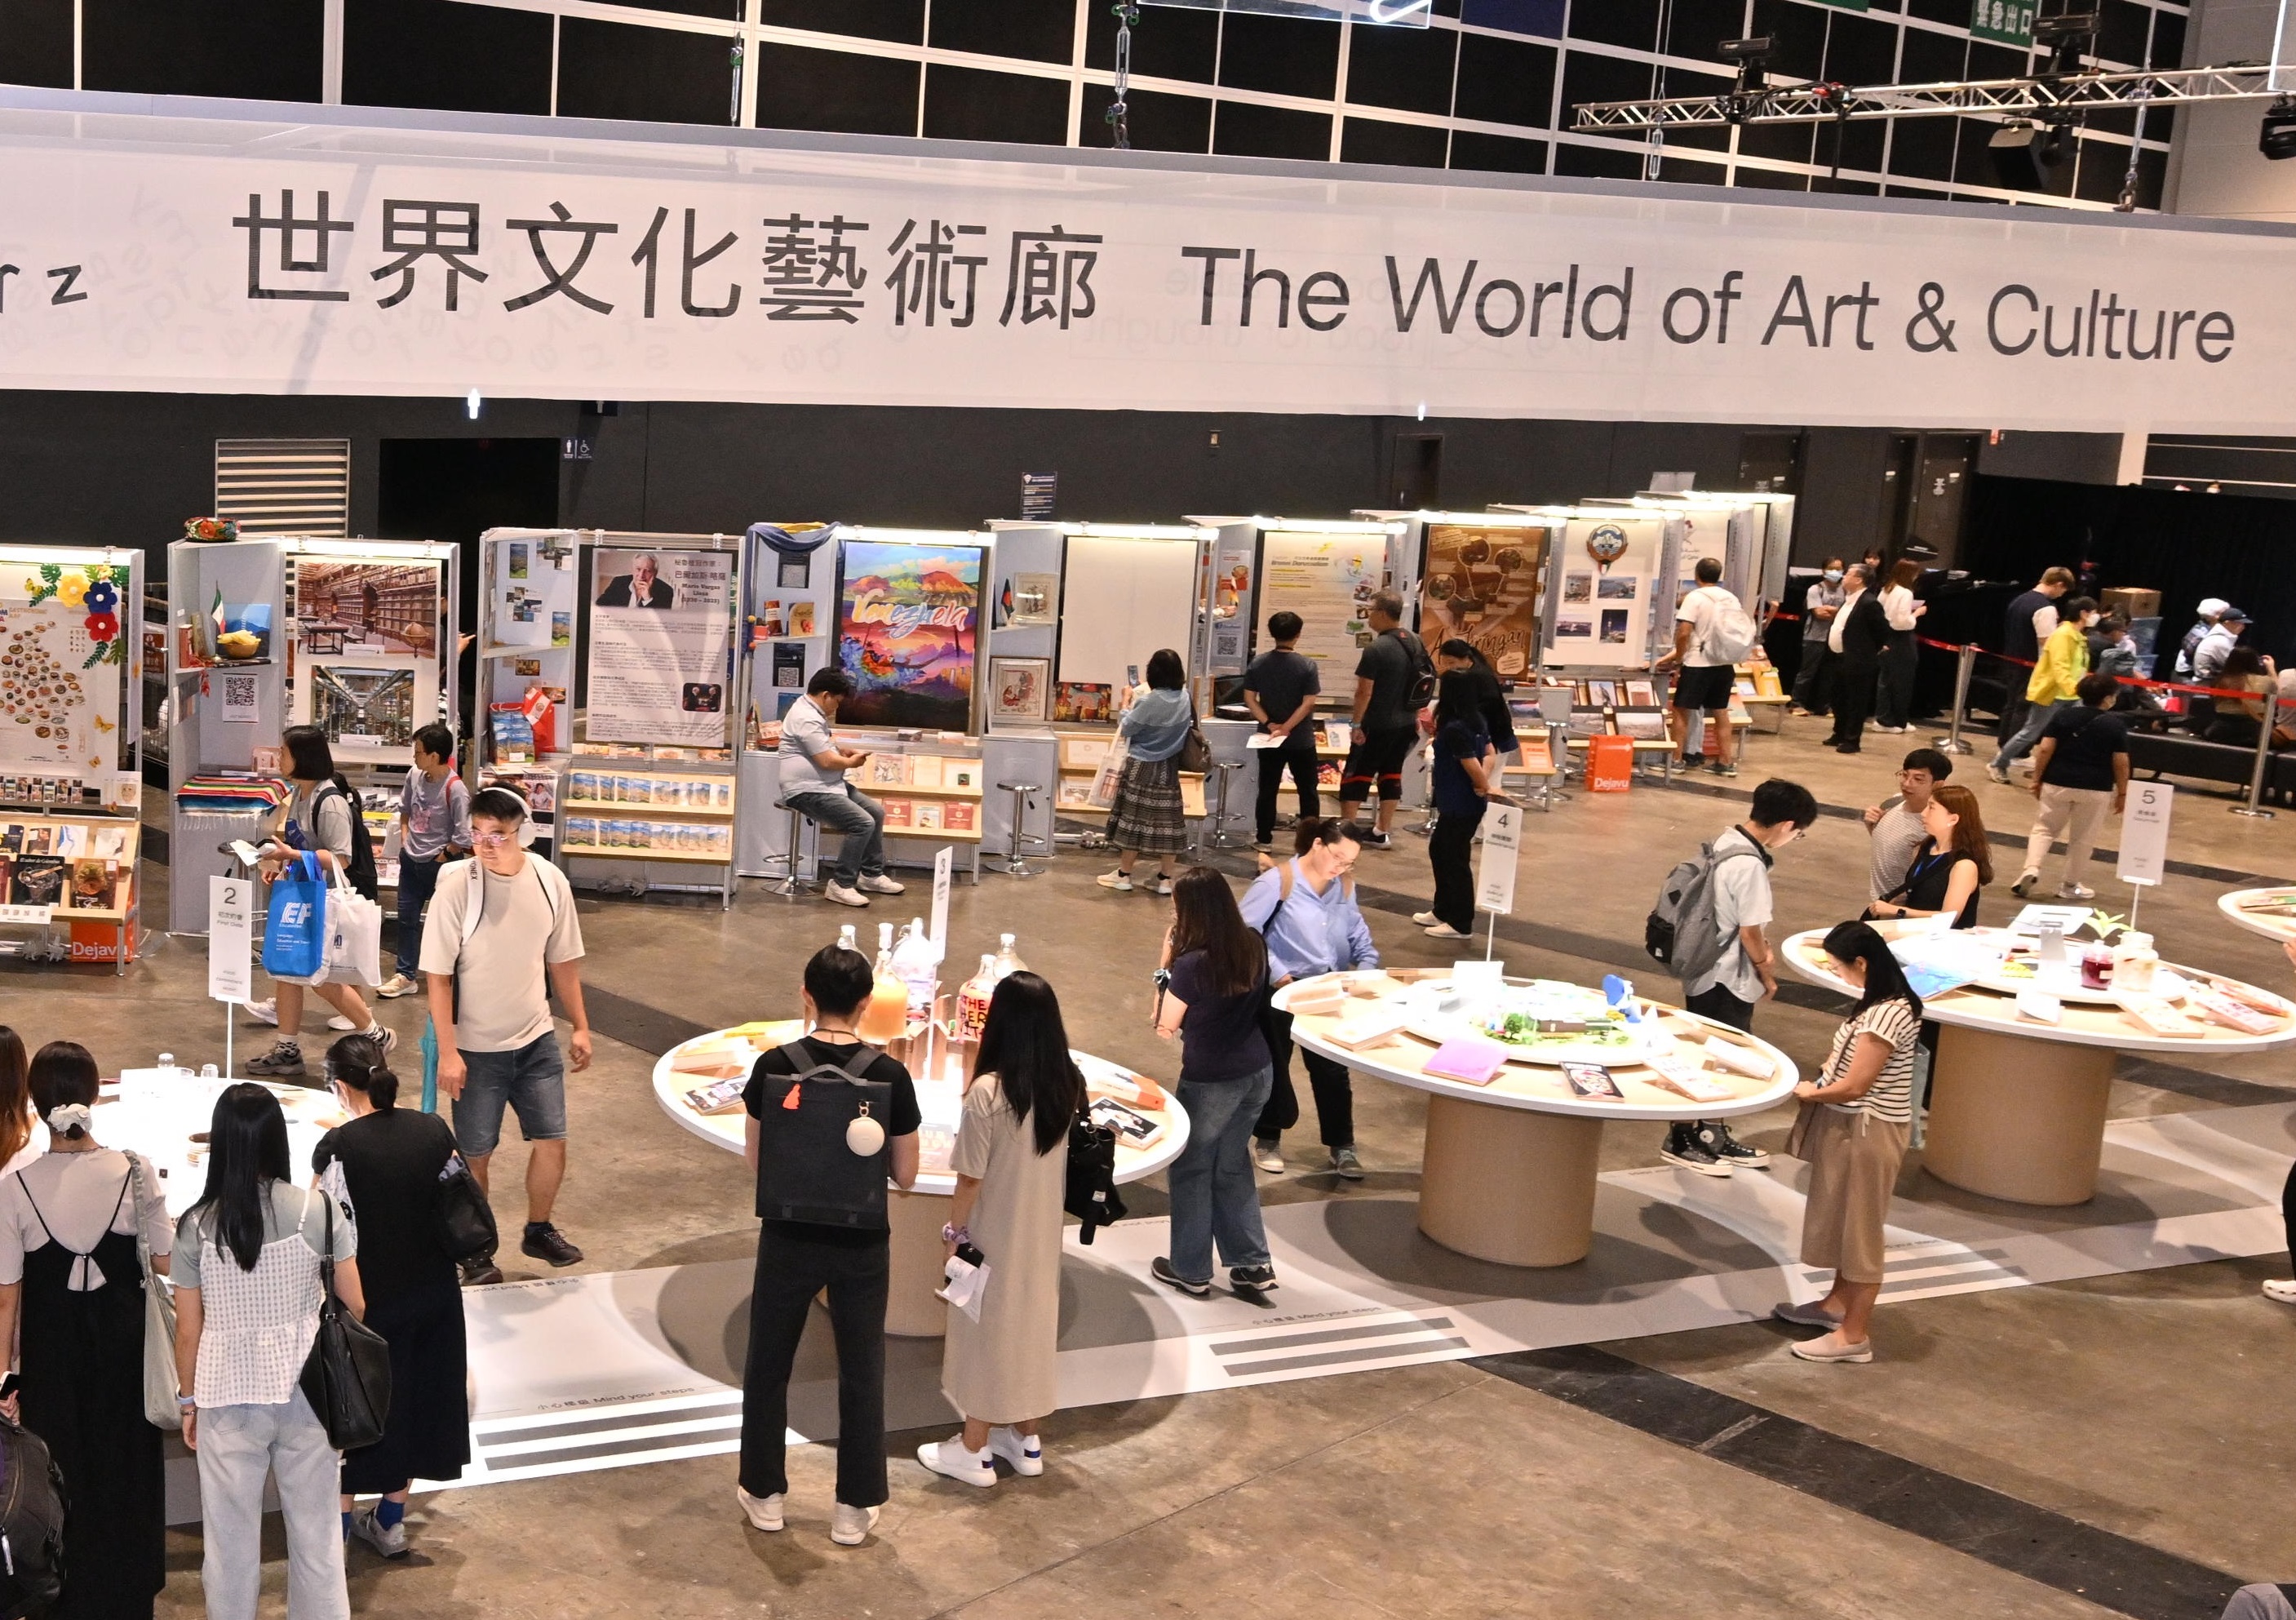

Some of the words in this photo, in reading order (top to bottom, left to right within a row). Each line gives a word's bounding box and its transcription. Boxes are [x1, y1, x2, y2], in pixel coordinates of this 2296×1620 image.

[47, 264, 88, 306] z
[233, 189, 1103, 331] 世界文化藝術廊
[1181, 246, 1350, 331] The
[1384, 255, 1634, 342] World
[1662, 270, 1744, 344] of
[1761, 274, 1880, 351] Art
[1905, 282, 1958, 353] &
[1987, 284, 2235, 363] Culture
[852, 588, 968, 639] Venezuela
[1593, 777, 1629, 791] Dejavu
[2142, 790, 2156, 805] 5
[1497, 813, 1509, 828] 4
[224, 887, 237, 905] 2
[281, 902, 312, 925] EF
[593, 1395, 625, 1404] Mind
[627, 1391, 655, 1400] your
[659, 1386, 695, 1396] steps
